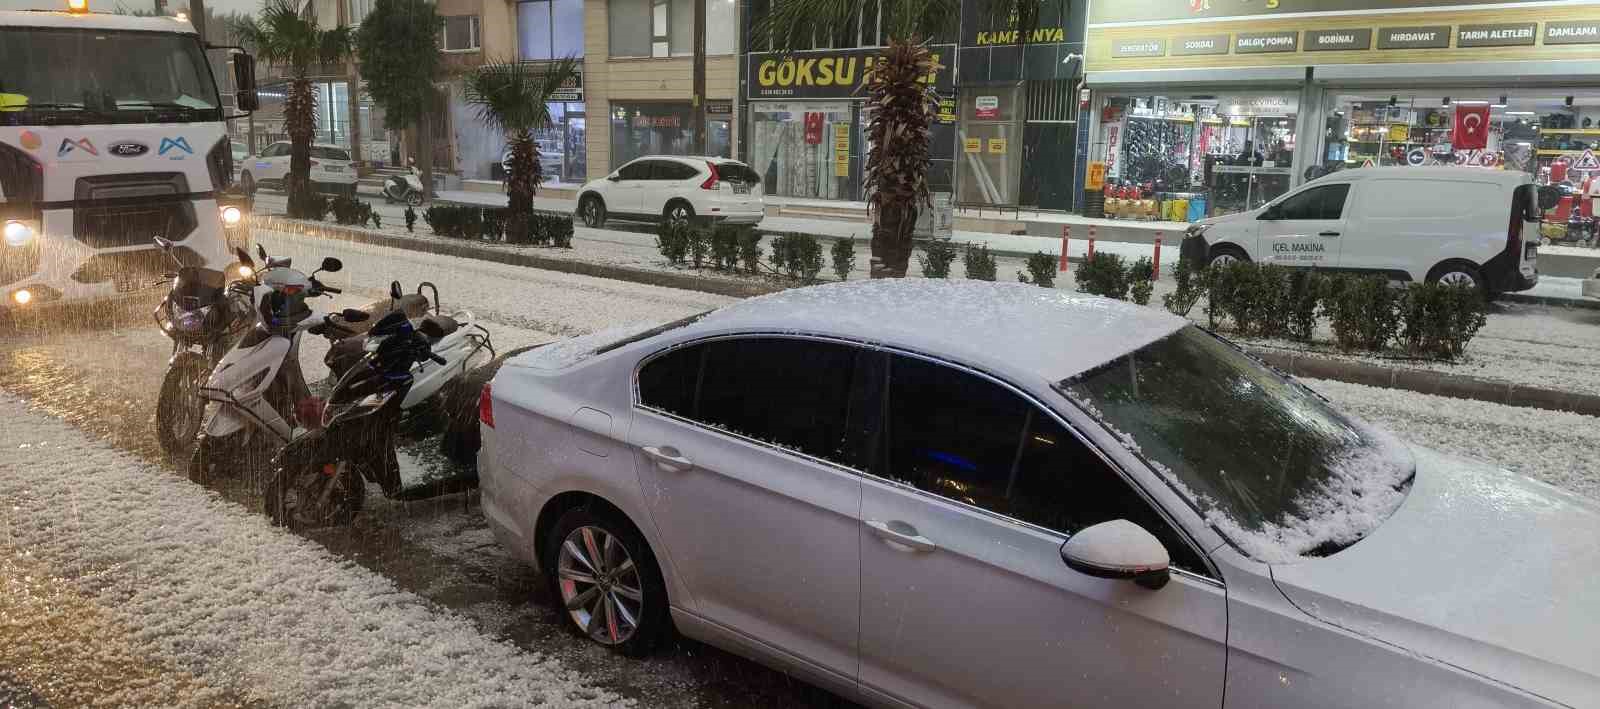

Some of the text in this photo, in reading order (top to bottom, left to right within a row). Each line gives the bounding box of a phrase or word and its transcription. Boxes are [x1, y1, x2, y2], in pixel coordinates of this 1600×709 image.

[976, 28, 1065, 45] KAMPNYA
[1318, 33, 1355, 44] BOBİNAJ
[1390, 32, 1437, 42] HIRDAVAT
[1460, 26, 1533, 40] TARIM ALETLERİ
[1549, 26, 1597, 37] DAMLAMA
[1238, 35, 1293, 49] DALGIÇ POMPA
[758, 55, 857, 87] GÖKSU
